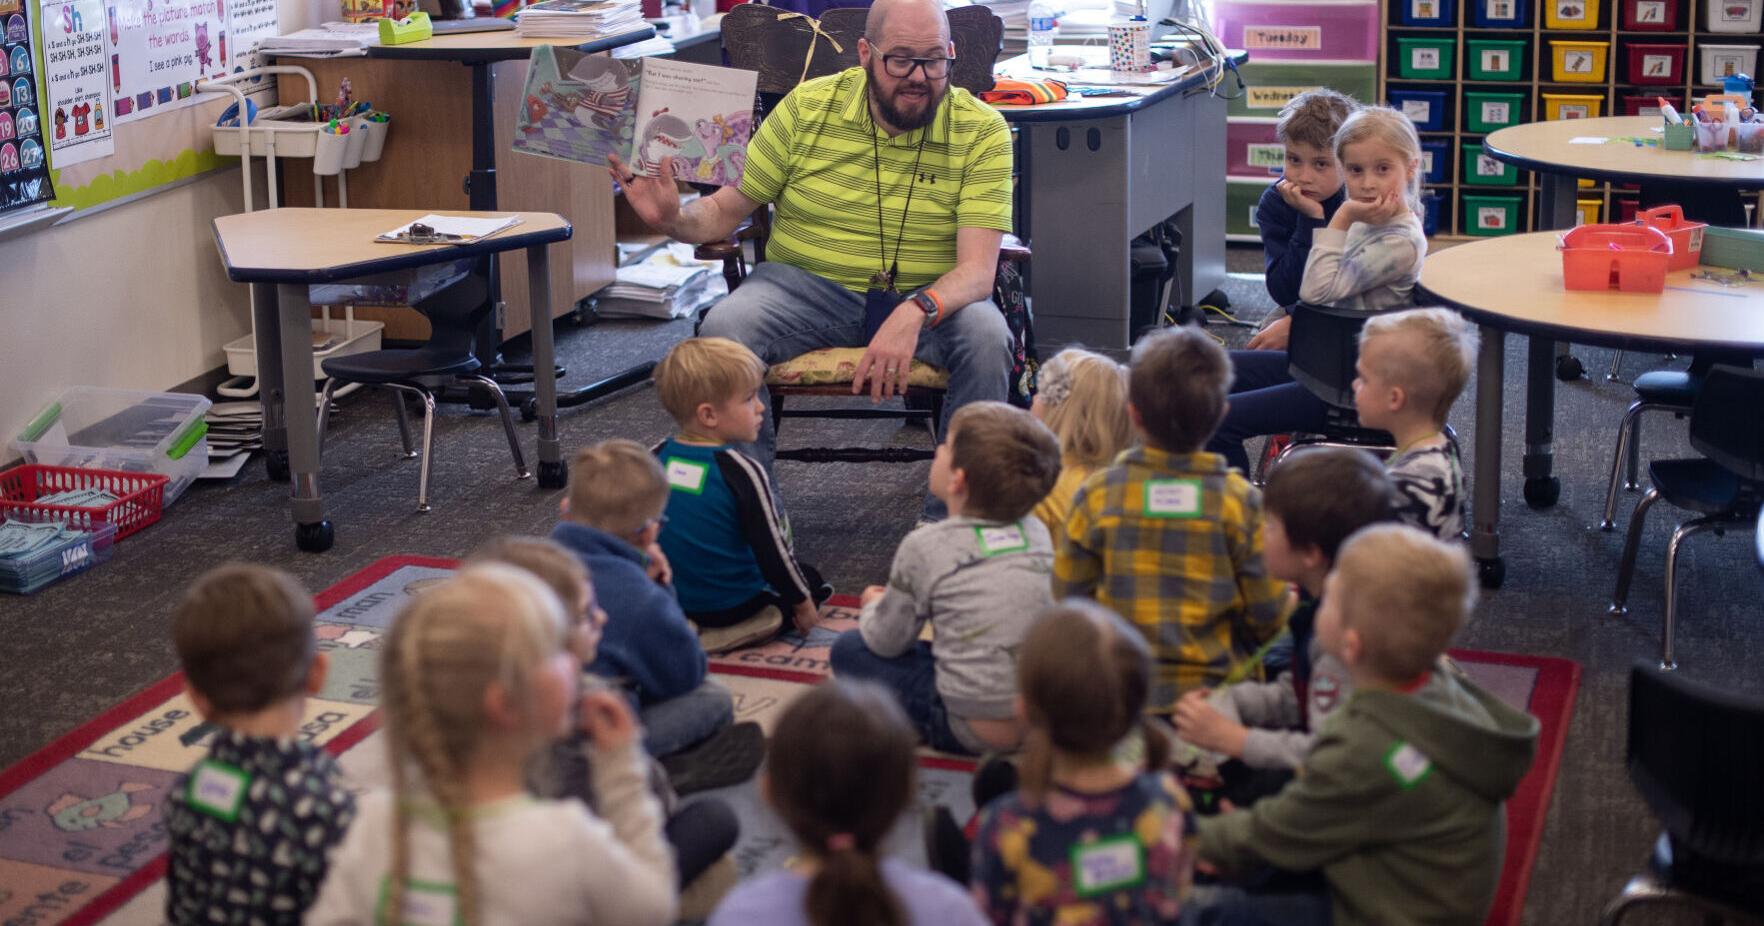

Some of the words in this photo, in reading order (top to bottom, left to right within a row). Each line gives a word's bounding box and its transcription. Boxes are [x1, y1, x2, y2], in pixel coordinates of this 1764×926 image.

[63, 5, 82, 33] Sh
[144, 11, 157, 25] the
[160, 7, 189, 23] picture
[191, 2, 215, 17] match
[148, 34, 162, 49] the
[1257, 32, 1308, 45] Tuesday
[16, 54, 26, 71] 6
[154, 61, 164, 71] see
[171, 56, 182, 70] pink
[15, 86, 28, 100] 13
[0, 121, 12, 138] 19
[19, 117, 34, 134] 20
[2, 153, 18, 169] 26
[23, 147, 38, 164] 27
[336, 592, 395, 619] man
[740, 652, 831, 670] cam
[87, 709, 190, 758] house
